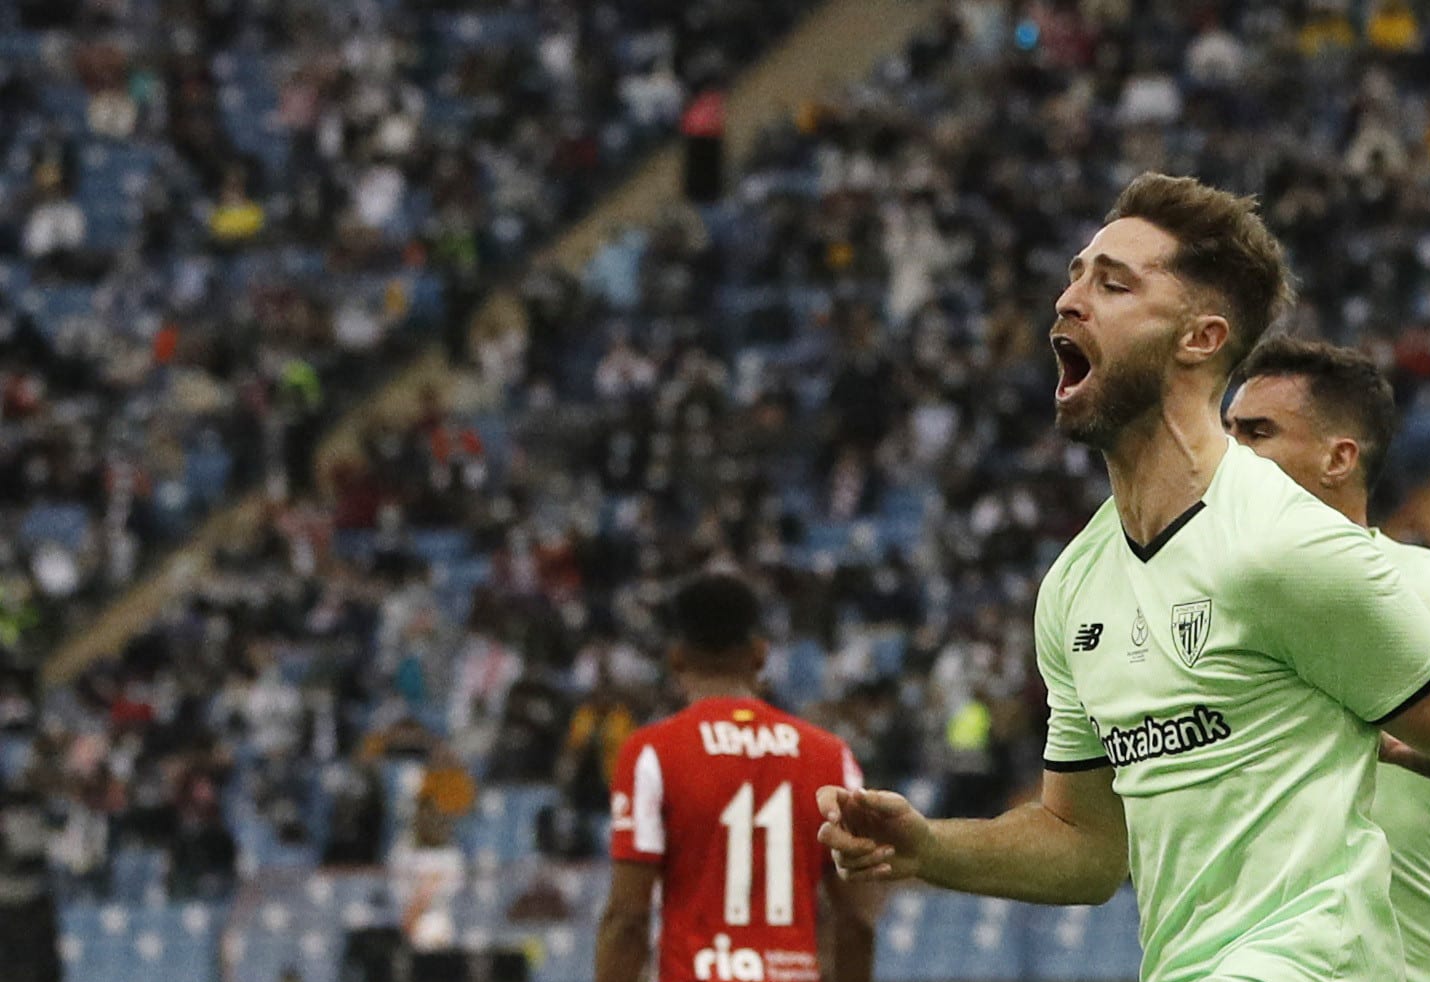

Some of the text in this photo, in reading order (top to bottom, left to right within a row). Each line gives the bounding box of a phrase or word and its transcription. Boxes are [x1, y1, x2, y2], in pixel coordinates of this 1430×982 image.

[698, 720, 801, 760] LEMAR
[1101, 704, 1231, 768] utxabank
[719, 780, 795, 927] 11
[693, 931, 766, 982] ria
